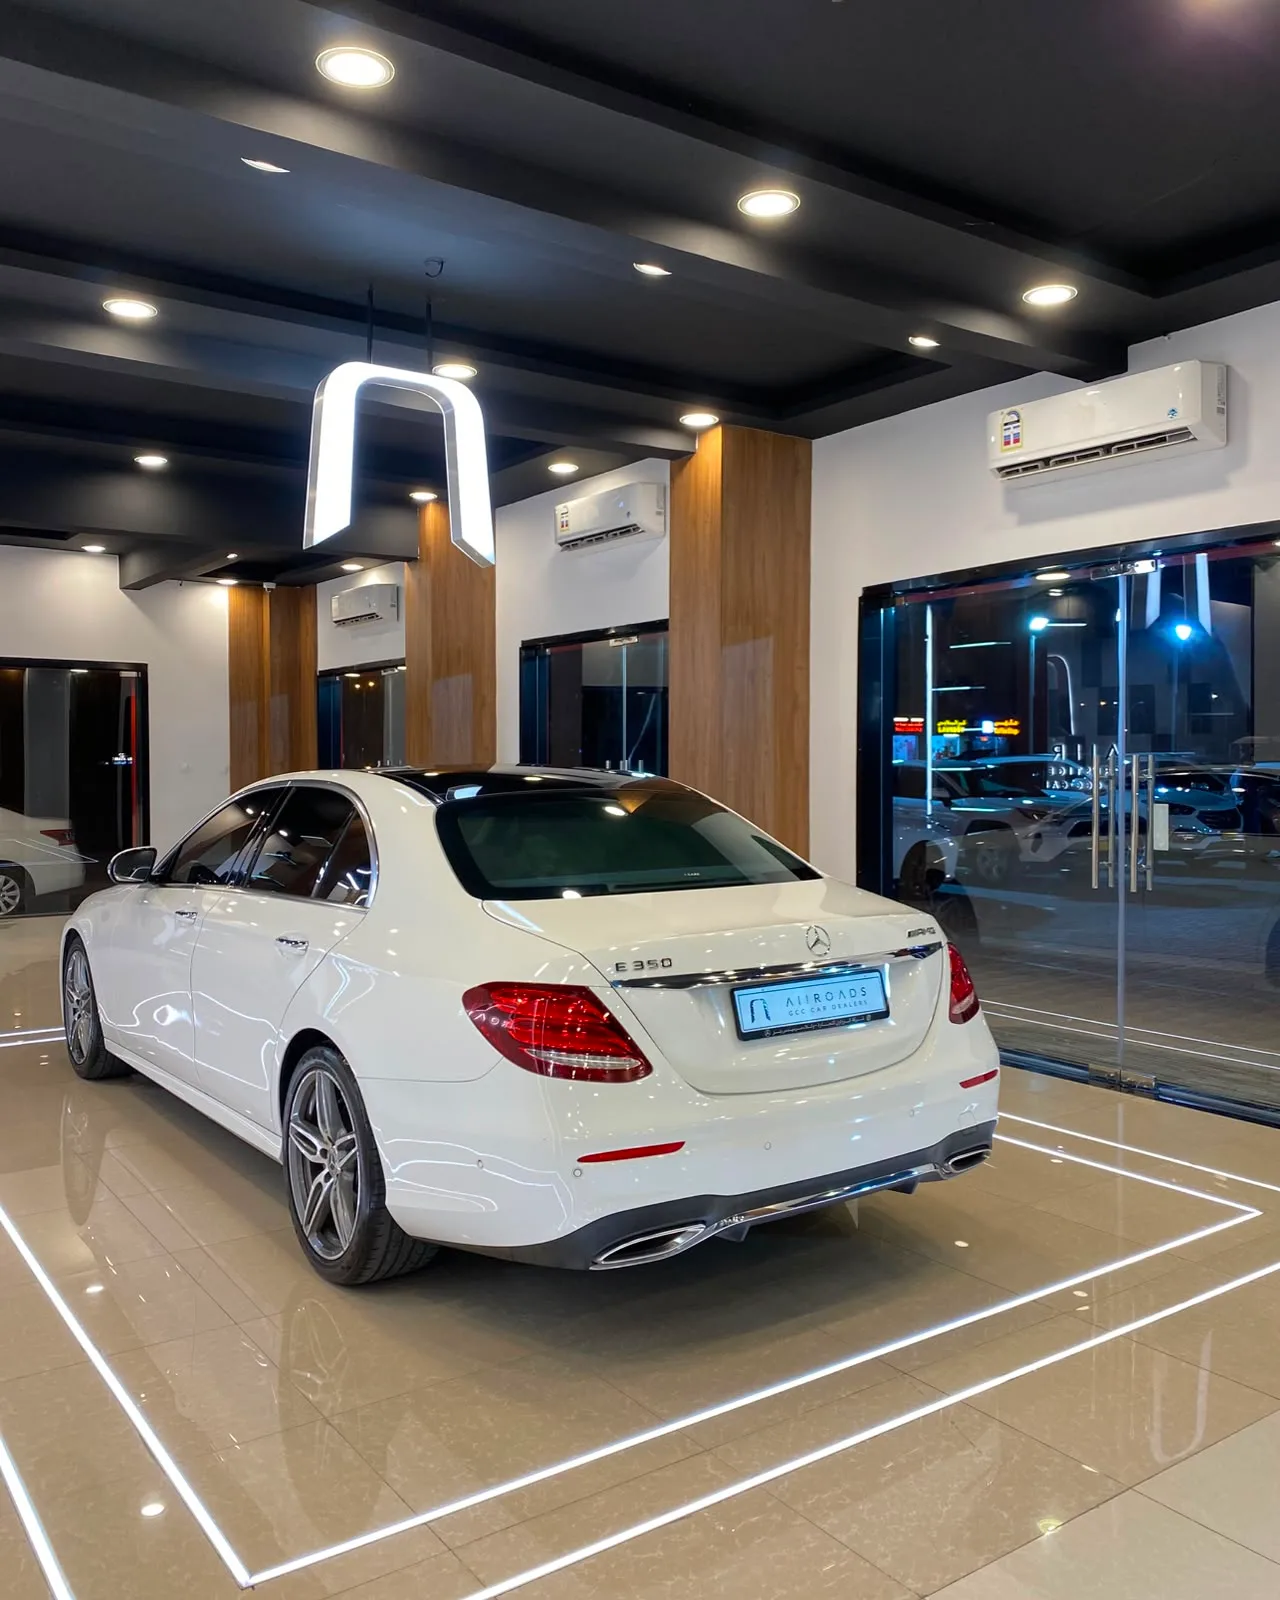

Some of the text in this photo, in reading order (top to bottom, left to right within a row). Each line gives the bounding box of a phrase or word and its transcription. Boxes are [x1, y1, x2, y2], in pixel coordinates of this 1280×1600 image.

[615, 957, 673, 972] E 350
[788, 1000, 868, 1017] GCC CAR DEALERS
